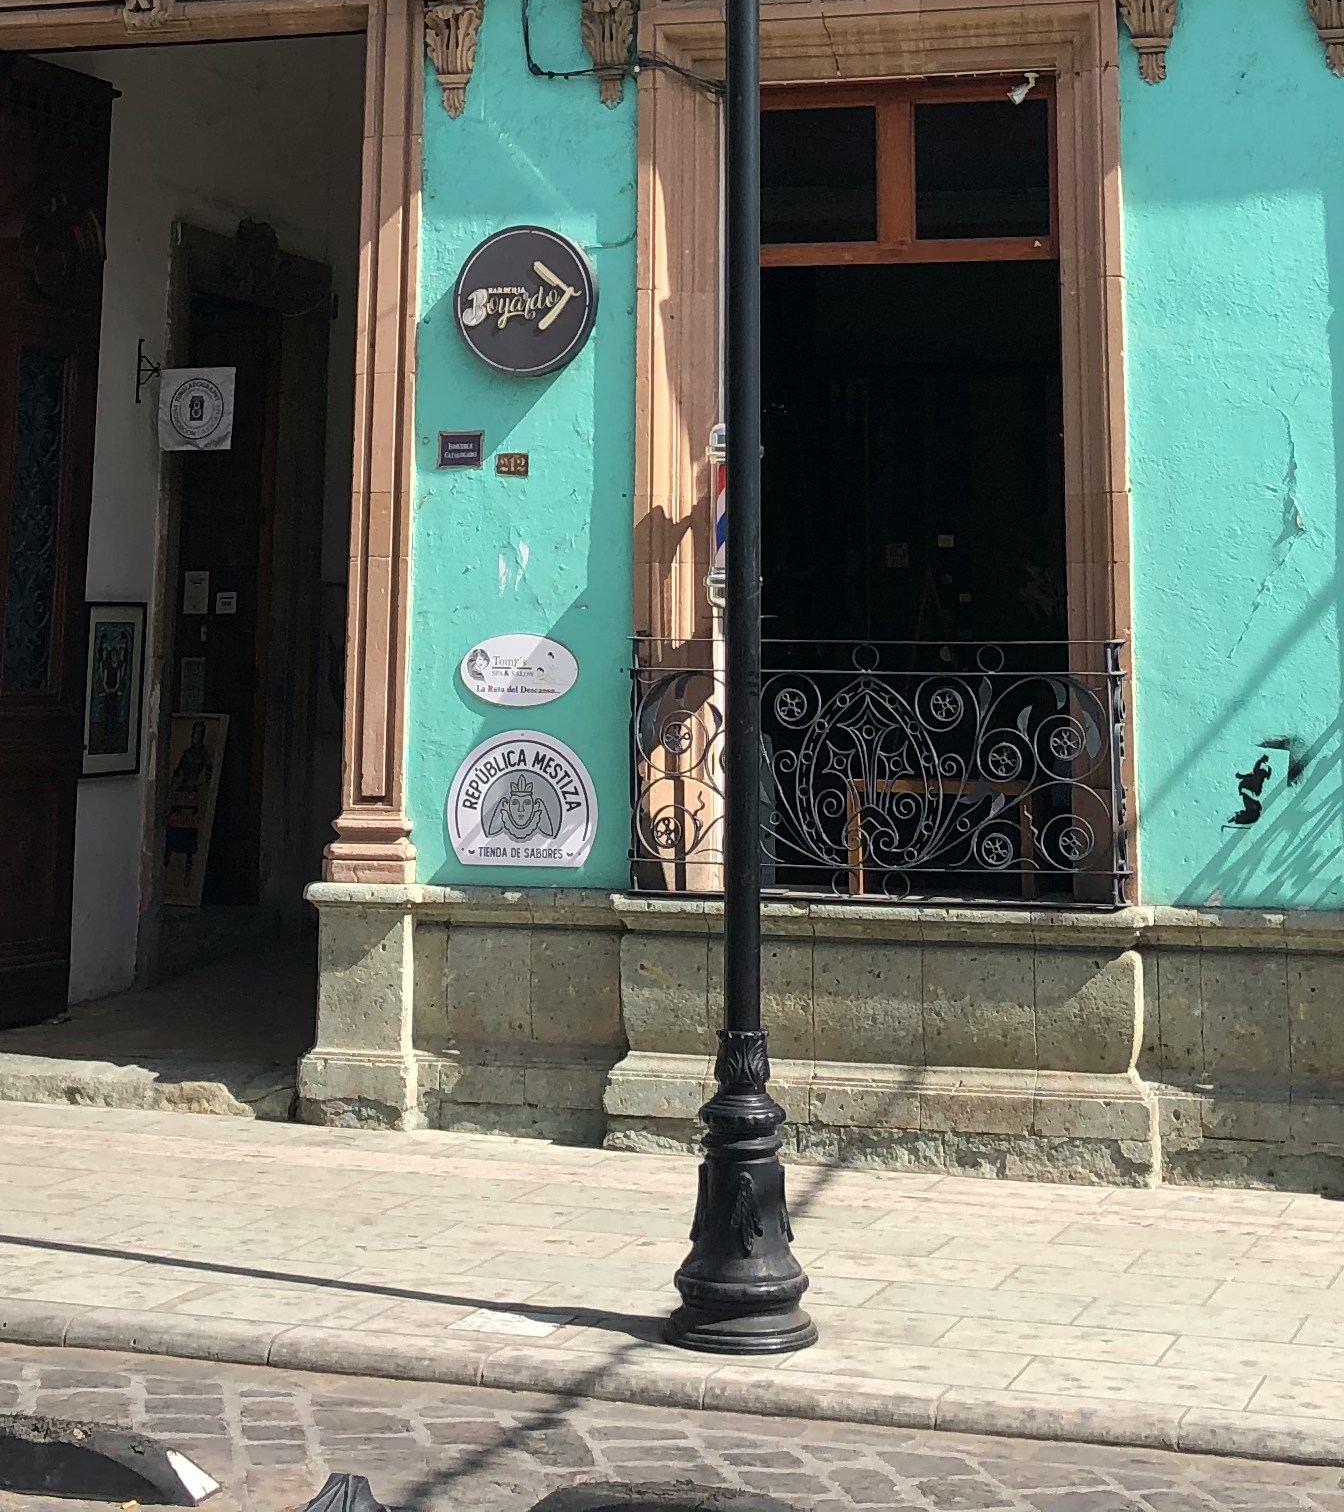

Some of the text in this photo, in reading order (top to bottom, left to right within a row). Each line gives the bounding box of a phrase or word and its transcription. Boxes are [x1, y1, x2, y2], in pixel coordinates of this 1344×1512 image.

[462, 286, 561, 329] Boyardo
[499, 457, 526, 472] 212
[462, 749, 582, 812] REPÚBLICA MESTIZA
[479, 847, 563, 859] TIENDA DE SABORES
